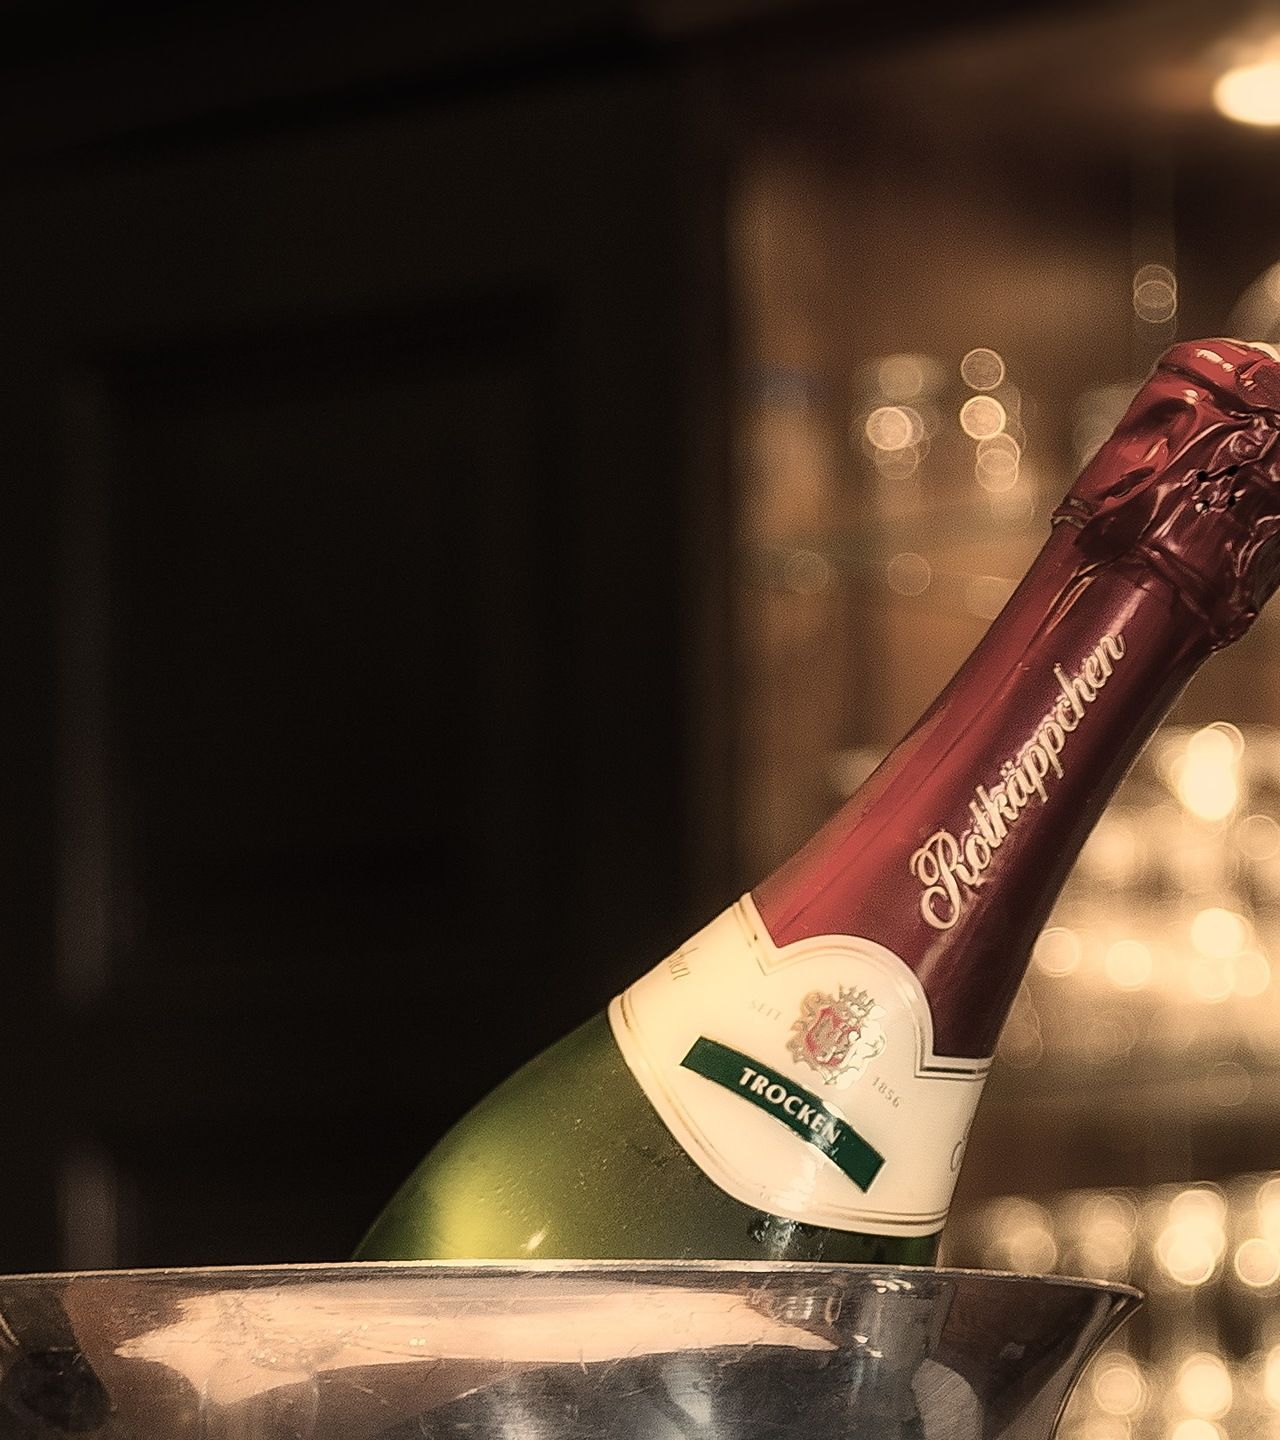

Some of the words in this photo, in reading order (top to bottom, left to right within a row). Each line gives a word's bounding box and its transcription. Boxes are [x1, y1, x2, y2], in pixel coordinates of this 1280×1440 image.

[908, 632, 1127, 930] Rotkäppchen
[738, 1066, 842, 1145] TROCKEN
[871, 1076, 901, 1109] 1856
